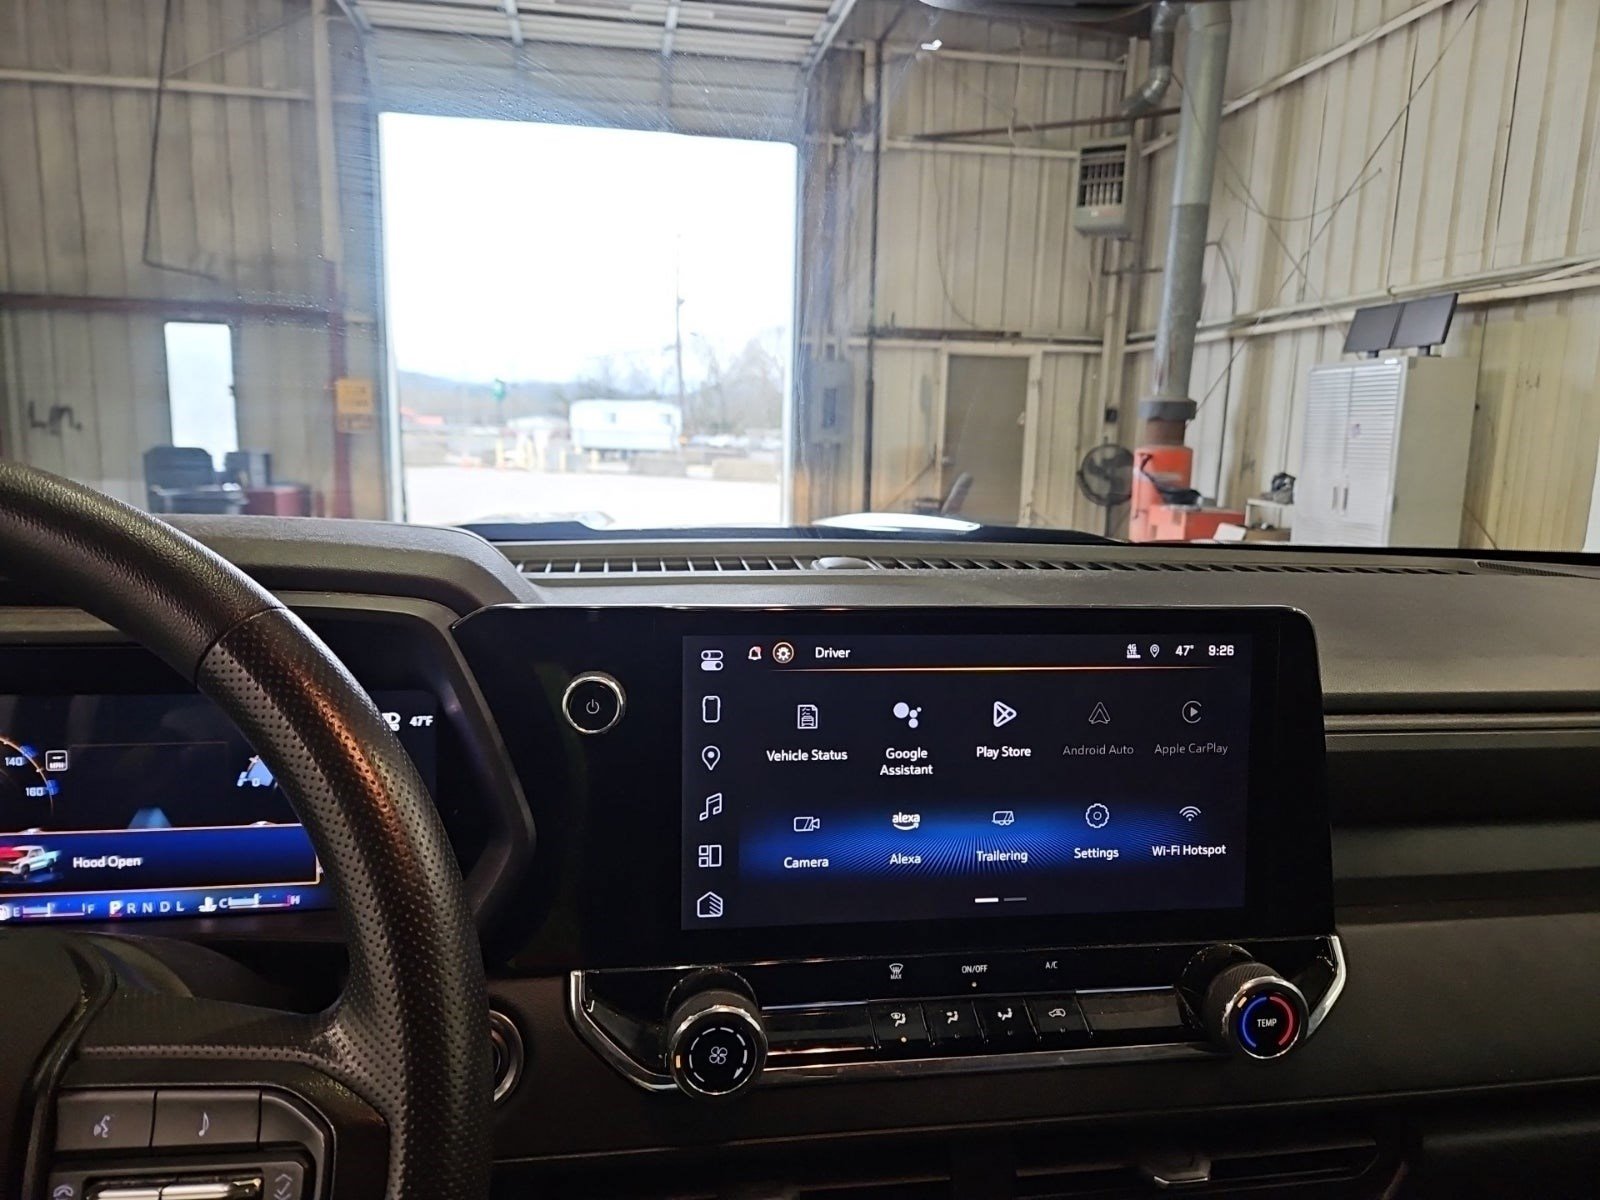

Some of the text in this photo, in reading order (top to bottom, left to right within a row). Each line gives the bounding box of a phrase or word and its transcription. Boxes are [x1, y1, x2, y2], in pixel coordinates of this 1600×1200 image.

[815, 647, 851, 659] Driver
[1175, 644, 1195, 656] 47°
[1208, 644, 1235, 656] 9:26
[766, 749, 848, 762] Vehicle Status
[885, 747, 928, 762] Google
[976, 745, 1031, 761] Play Store
[1063, 744, 1134, 756] Android Auto
[1154, 742, 1228, 757] Apple CarPlay
[5, 756, 24, 767] 140
[880, 764, 933, 776] Assistant
[25, 787, 44, 797] 160
[892, 811, 921, 824] alexa
[976, 849, 1029, 863] Trailering
[1074, 847, 1119, 861] Settings
[1152, 844, 1227, 858] Wi-Fi Hotspot
[73, 855, 142, 869] Hood Open
[783, 856, 829, 869] Camera
[889, 853, 922, 865] Alexa
[109, 901, 184, 915] P R N D L
[961, 964, 988, 974] ON/OFF
[1045, 961, 1058, 970] A/C
[1256, 1018, 1277, 1028] TEMP
